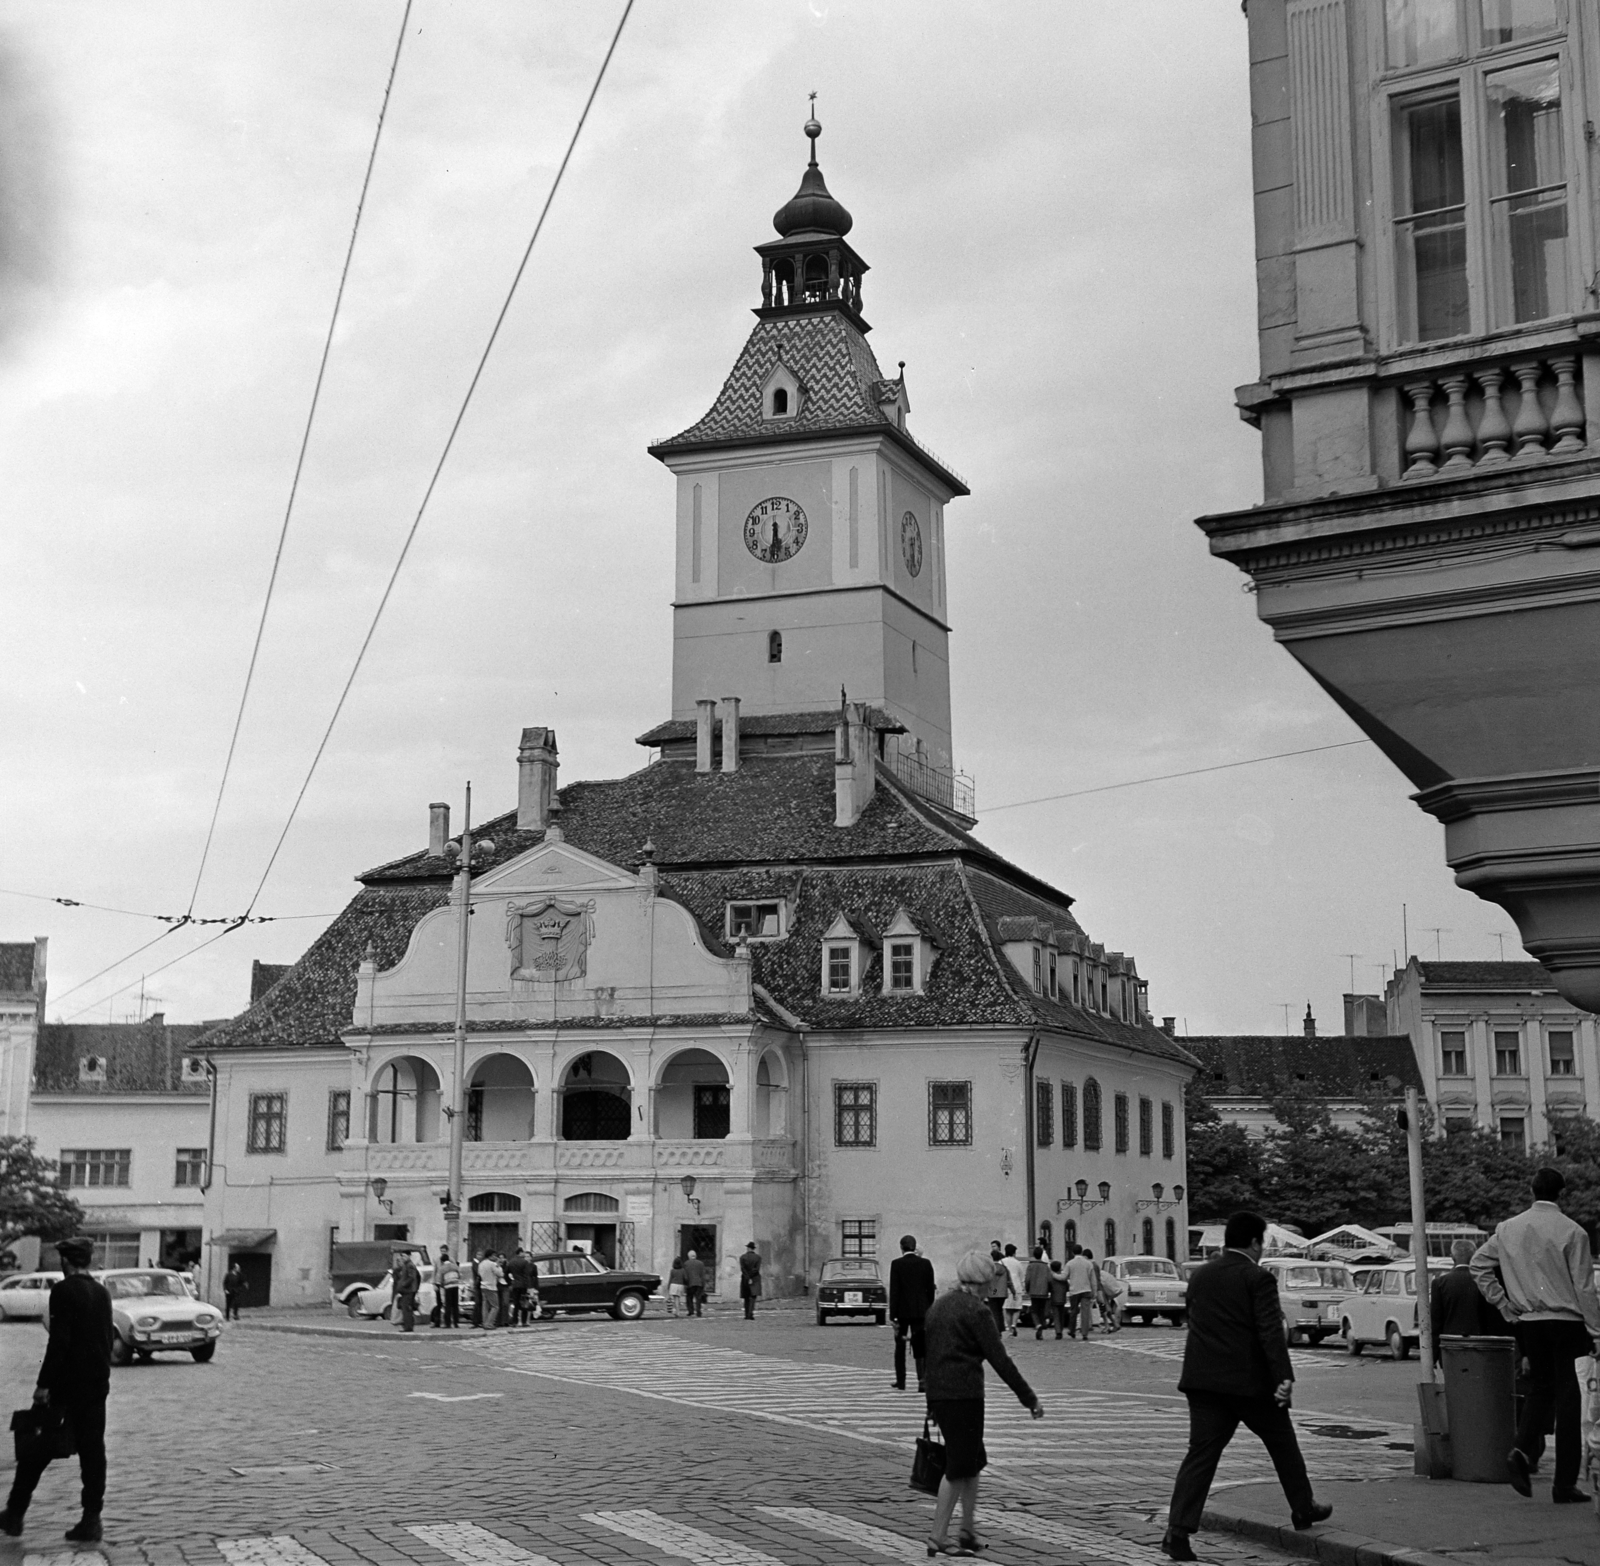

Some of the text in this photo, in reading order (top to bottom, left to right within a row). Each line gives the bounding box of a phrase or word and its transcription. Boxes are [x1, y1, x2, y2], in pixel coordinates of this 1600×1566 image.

[760, 505, 768, 515] 11
[770, 500, 782, 511] 12
[785, 503, 790, 513] 1
[751, 515, 760, 526] 10
[793, 510, 800, 520] 2
[748, 527, 755, 538] 9
[797, 522, 804, 534] 3
[752, 539, 758, 550] 8
[793, 536, 800, 546] 4
[761, 548, 767, 559] 7
[784, 546, 791, 556] 5
